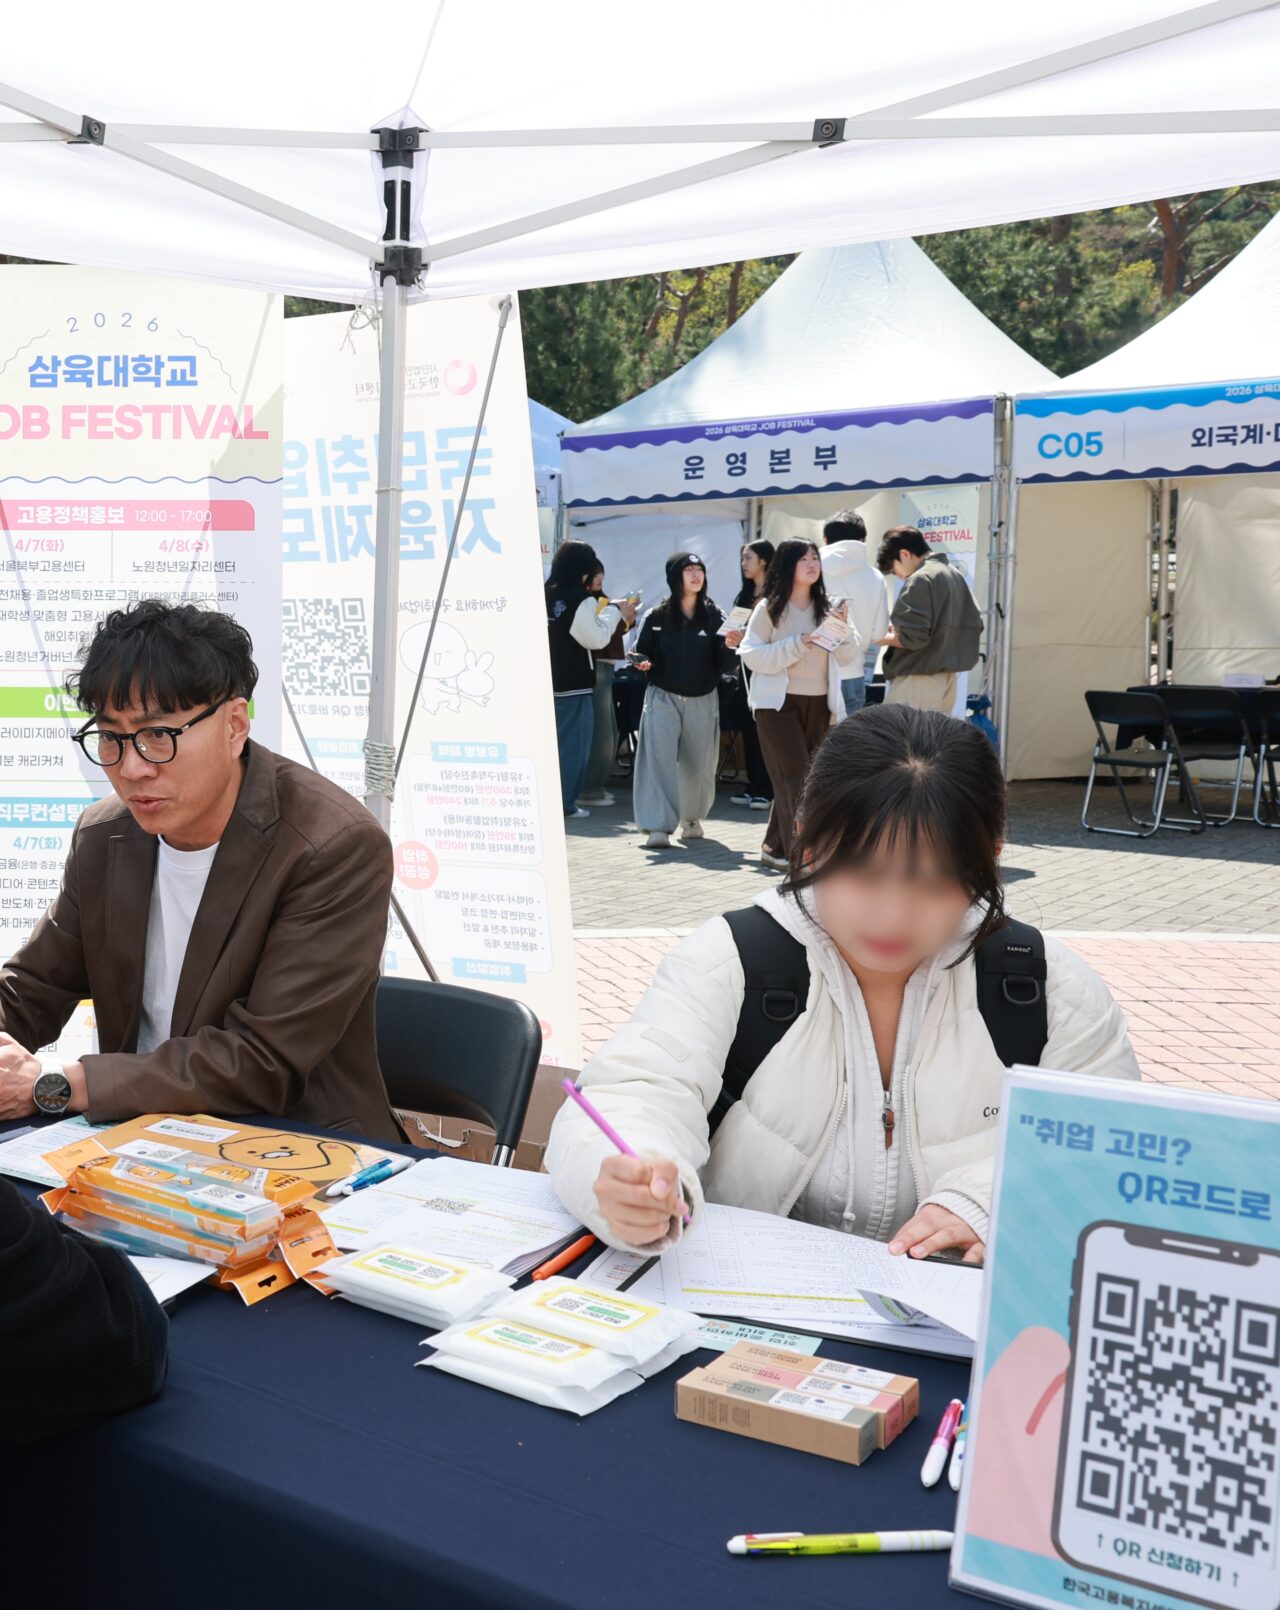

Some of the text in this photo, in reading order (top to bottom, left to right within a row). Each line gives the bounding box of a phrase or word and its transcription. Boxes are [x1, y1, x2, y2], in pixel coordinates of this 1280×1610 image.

[67, 312, 158, 333] 2026
[27, 354, 198, 388] 삼육대학교
[1225, 386, 1252, 397] 2026
[61, 404, 269, 440] FESTIVAL
[705, 427, 723, 435] 2026
[759, 421, 776, 431] JOB
[777, 418, 816, 430] FESTIVAL
[1037, 431, 1103, 459] C05
[17, 506, 125, 524] 고용정책홍보
[134, 510, 167, 522] 12:00
[180, 510, 212, 522] 17:00
[917, 515, 958, 528] 삼육대학교
[924, 529, 973, 543] FESTIVAL
[15, 538, 65, 553] 4/7(화)
[159, 539, 209, 553] 4/8(수)
[132, 561, 236, 573] 노원청년일자리센터
[33, 610, 67, 622] 맞춤형
[18, 755, 64, 767] 캐리커쳐
[13, 836, 63, 850] 4/7(화)
[982, 1105, 1000, 1118] Co
[1020, 1114, 1192, 1166] "취업 고민?
[1117, 1171, 1272, 1221] QR코드로
[1113, 1538, 1222, 1582] QR 신청하기
